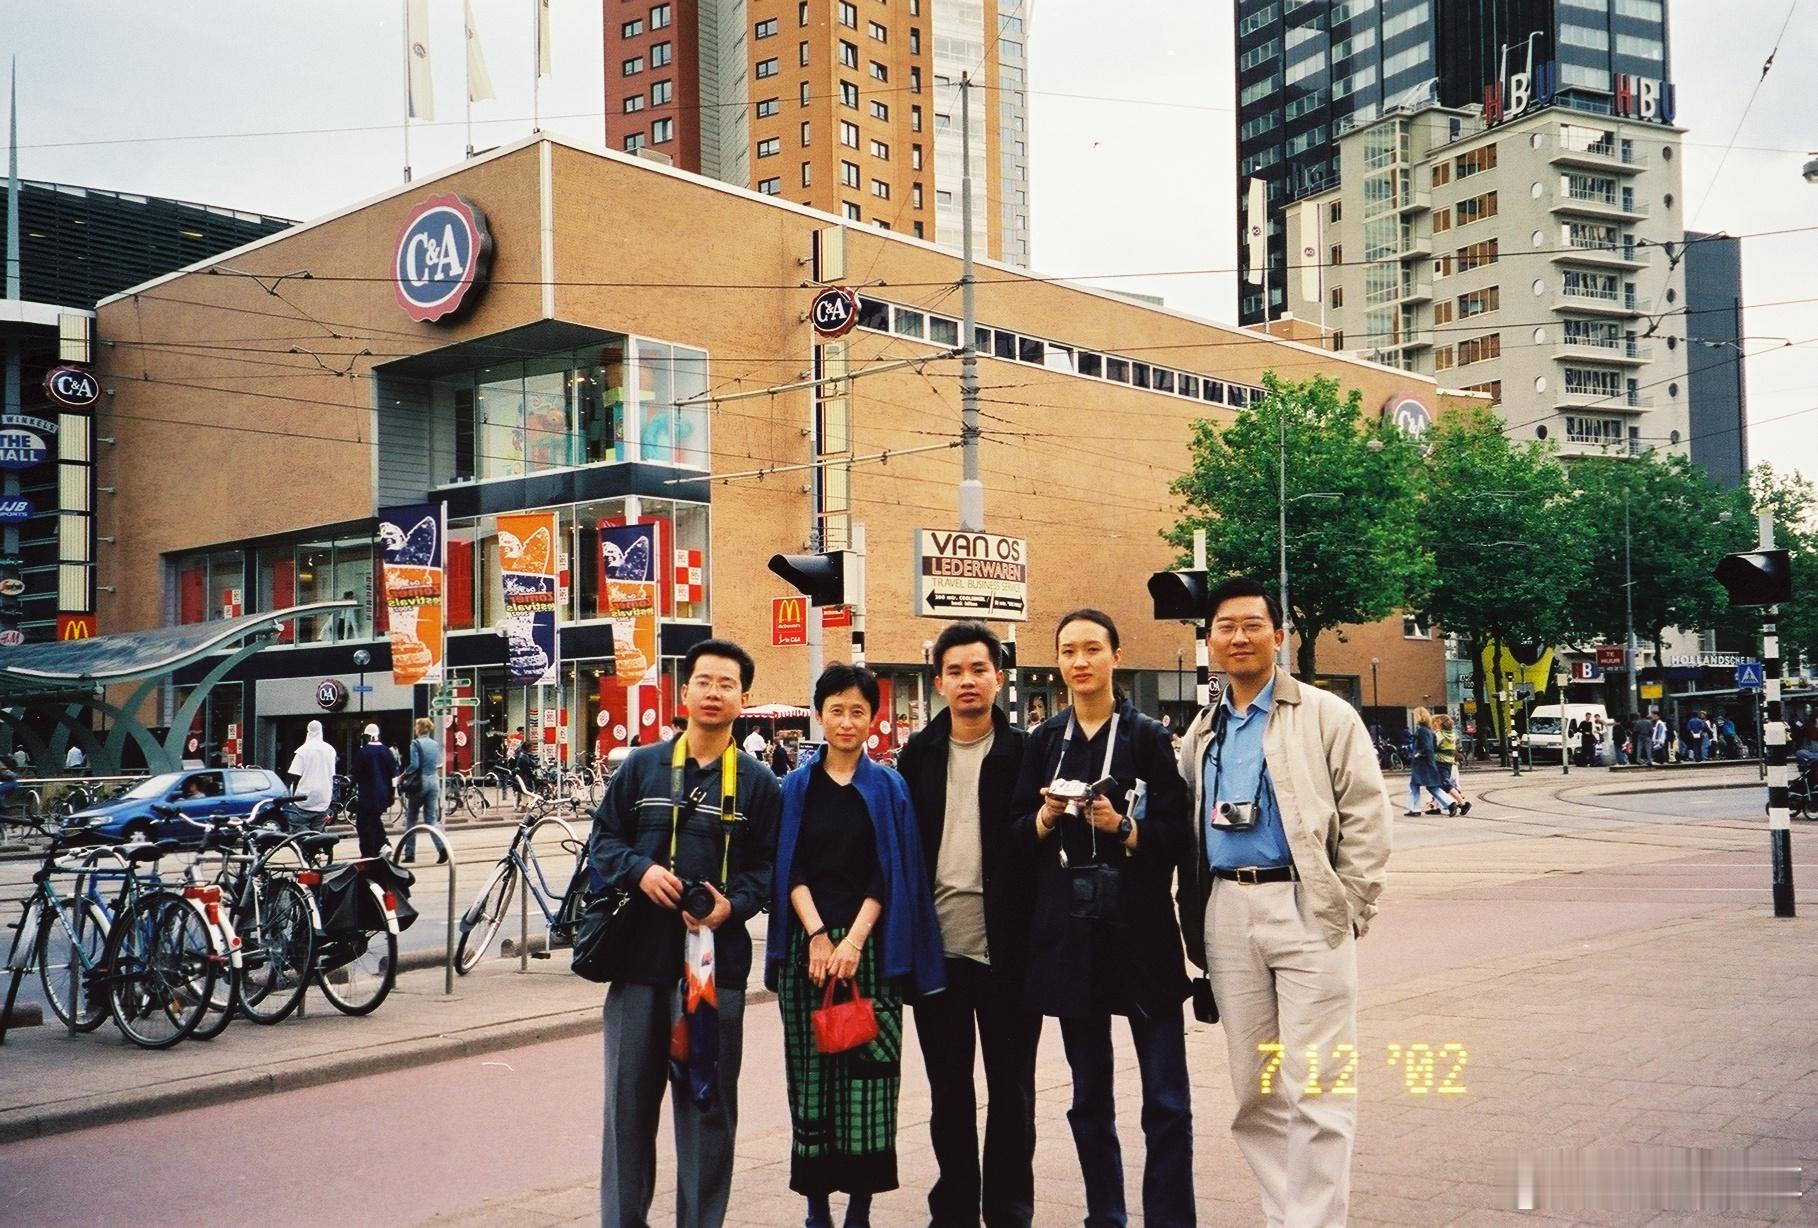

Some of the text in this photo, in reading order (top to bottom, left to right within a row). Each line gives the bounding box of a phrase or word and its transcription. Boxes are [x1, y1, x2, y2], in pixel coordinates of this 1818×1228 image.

[1484, 60, 1557, 124] HBU
[1615, 73, 1676, 120] HBU
[406, 223, 463, 287] C&A
[816, 297, 848, 323] C&A
[57, 376, 94, 398] C&A
[6, 415, 55, 431] WINKELS
[0, 434, 31, 448] THE
[0, 449, 39, 461] ALL
[931, 532, 1020, 561] VAN OS
[931, 557, 1021, 580] LEDERWAREN
[932, 578, 965, 589] TRAVEL
[967, 580, 1000, 591] BUSINESS
